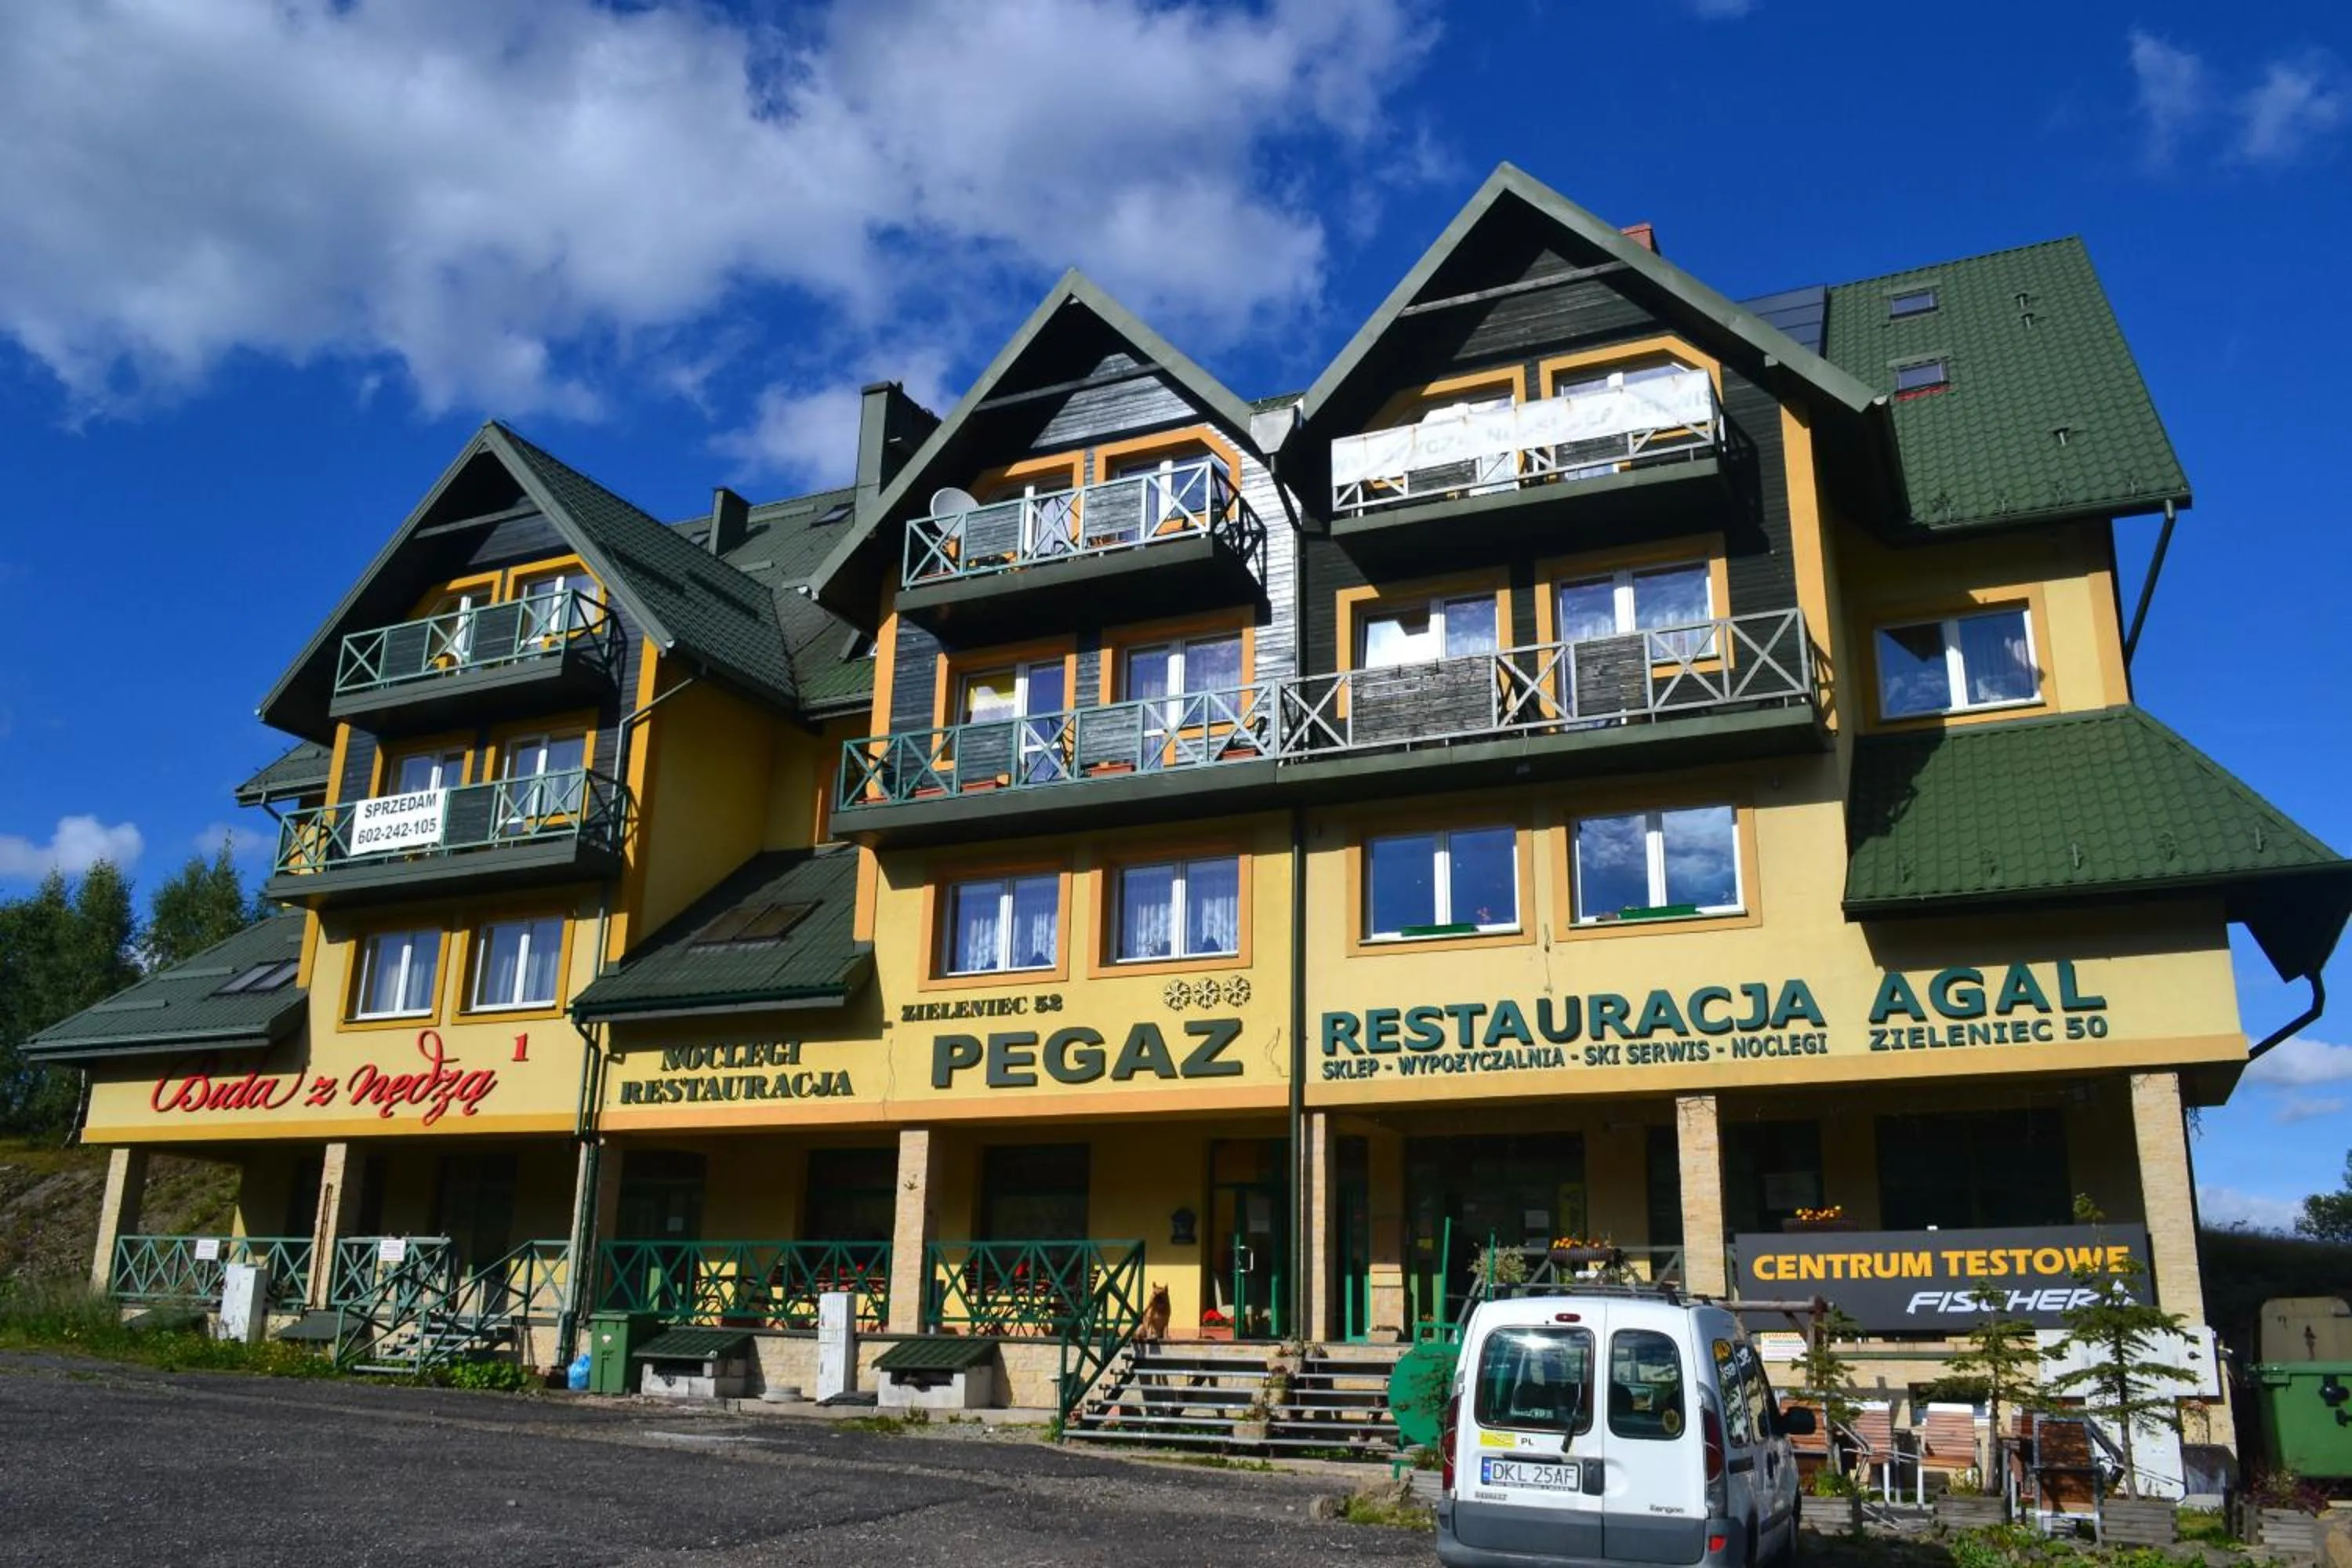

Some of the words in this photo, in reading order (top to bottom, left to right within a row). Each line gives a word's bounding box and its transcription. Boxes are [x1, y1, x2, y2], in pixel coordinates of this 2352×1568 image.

[365, 793, 437, 818] SPRZEDAM
[358, 818, 437, 844] 602-242-105
[902, 996, 1028, 1022] ZIELENIEC
[1320, 979, 1828, 1056] RESTAURACJA
[1869, 960, 2107, 1024] AGAL
[1869, 1019, 2054, 1051] ZIELENIEC
[2065, 1016, 2109, 1041] 50
[304, 1076, 336, 1107] z
[511, 1033, 529, 1062] 1
[661, 1040, 801, 1072] NOCLEGI
[931, 1018, 1243, 1088] PEGAZ
[1322, 1058, 1380, 1080] SKLEP
[1585, 1044, 1620, 1065] SKI
[1625, 1040, 1710, 1065] SERWIS
[1732, 1032, 1828, 1059] NOCLEGI
[619, 1069, 855, 1105] RESTAURACJA
[1752, 1249, 1933, 1280] CENTRUM
[1941, 1245, 2131, 1277] TESTOWE
[1492, 1462, 1526, 1482] DKL
[1534, 1465, 1575, 1485] 25AF
